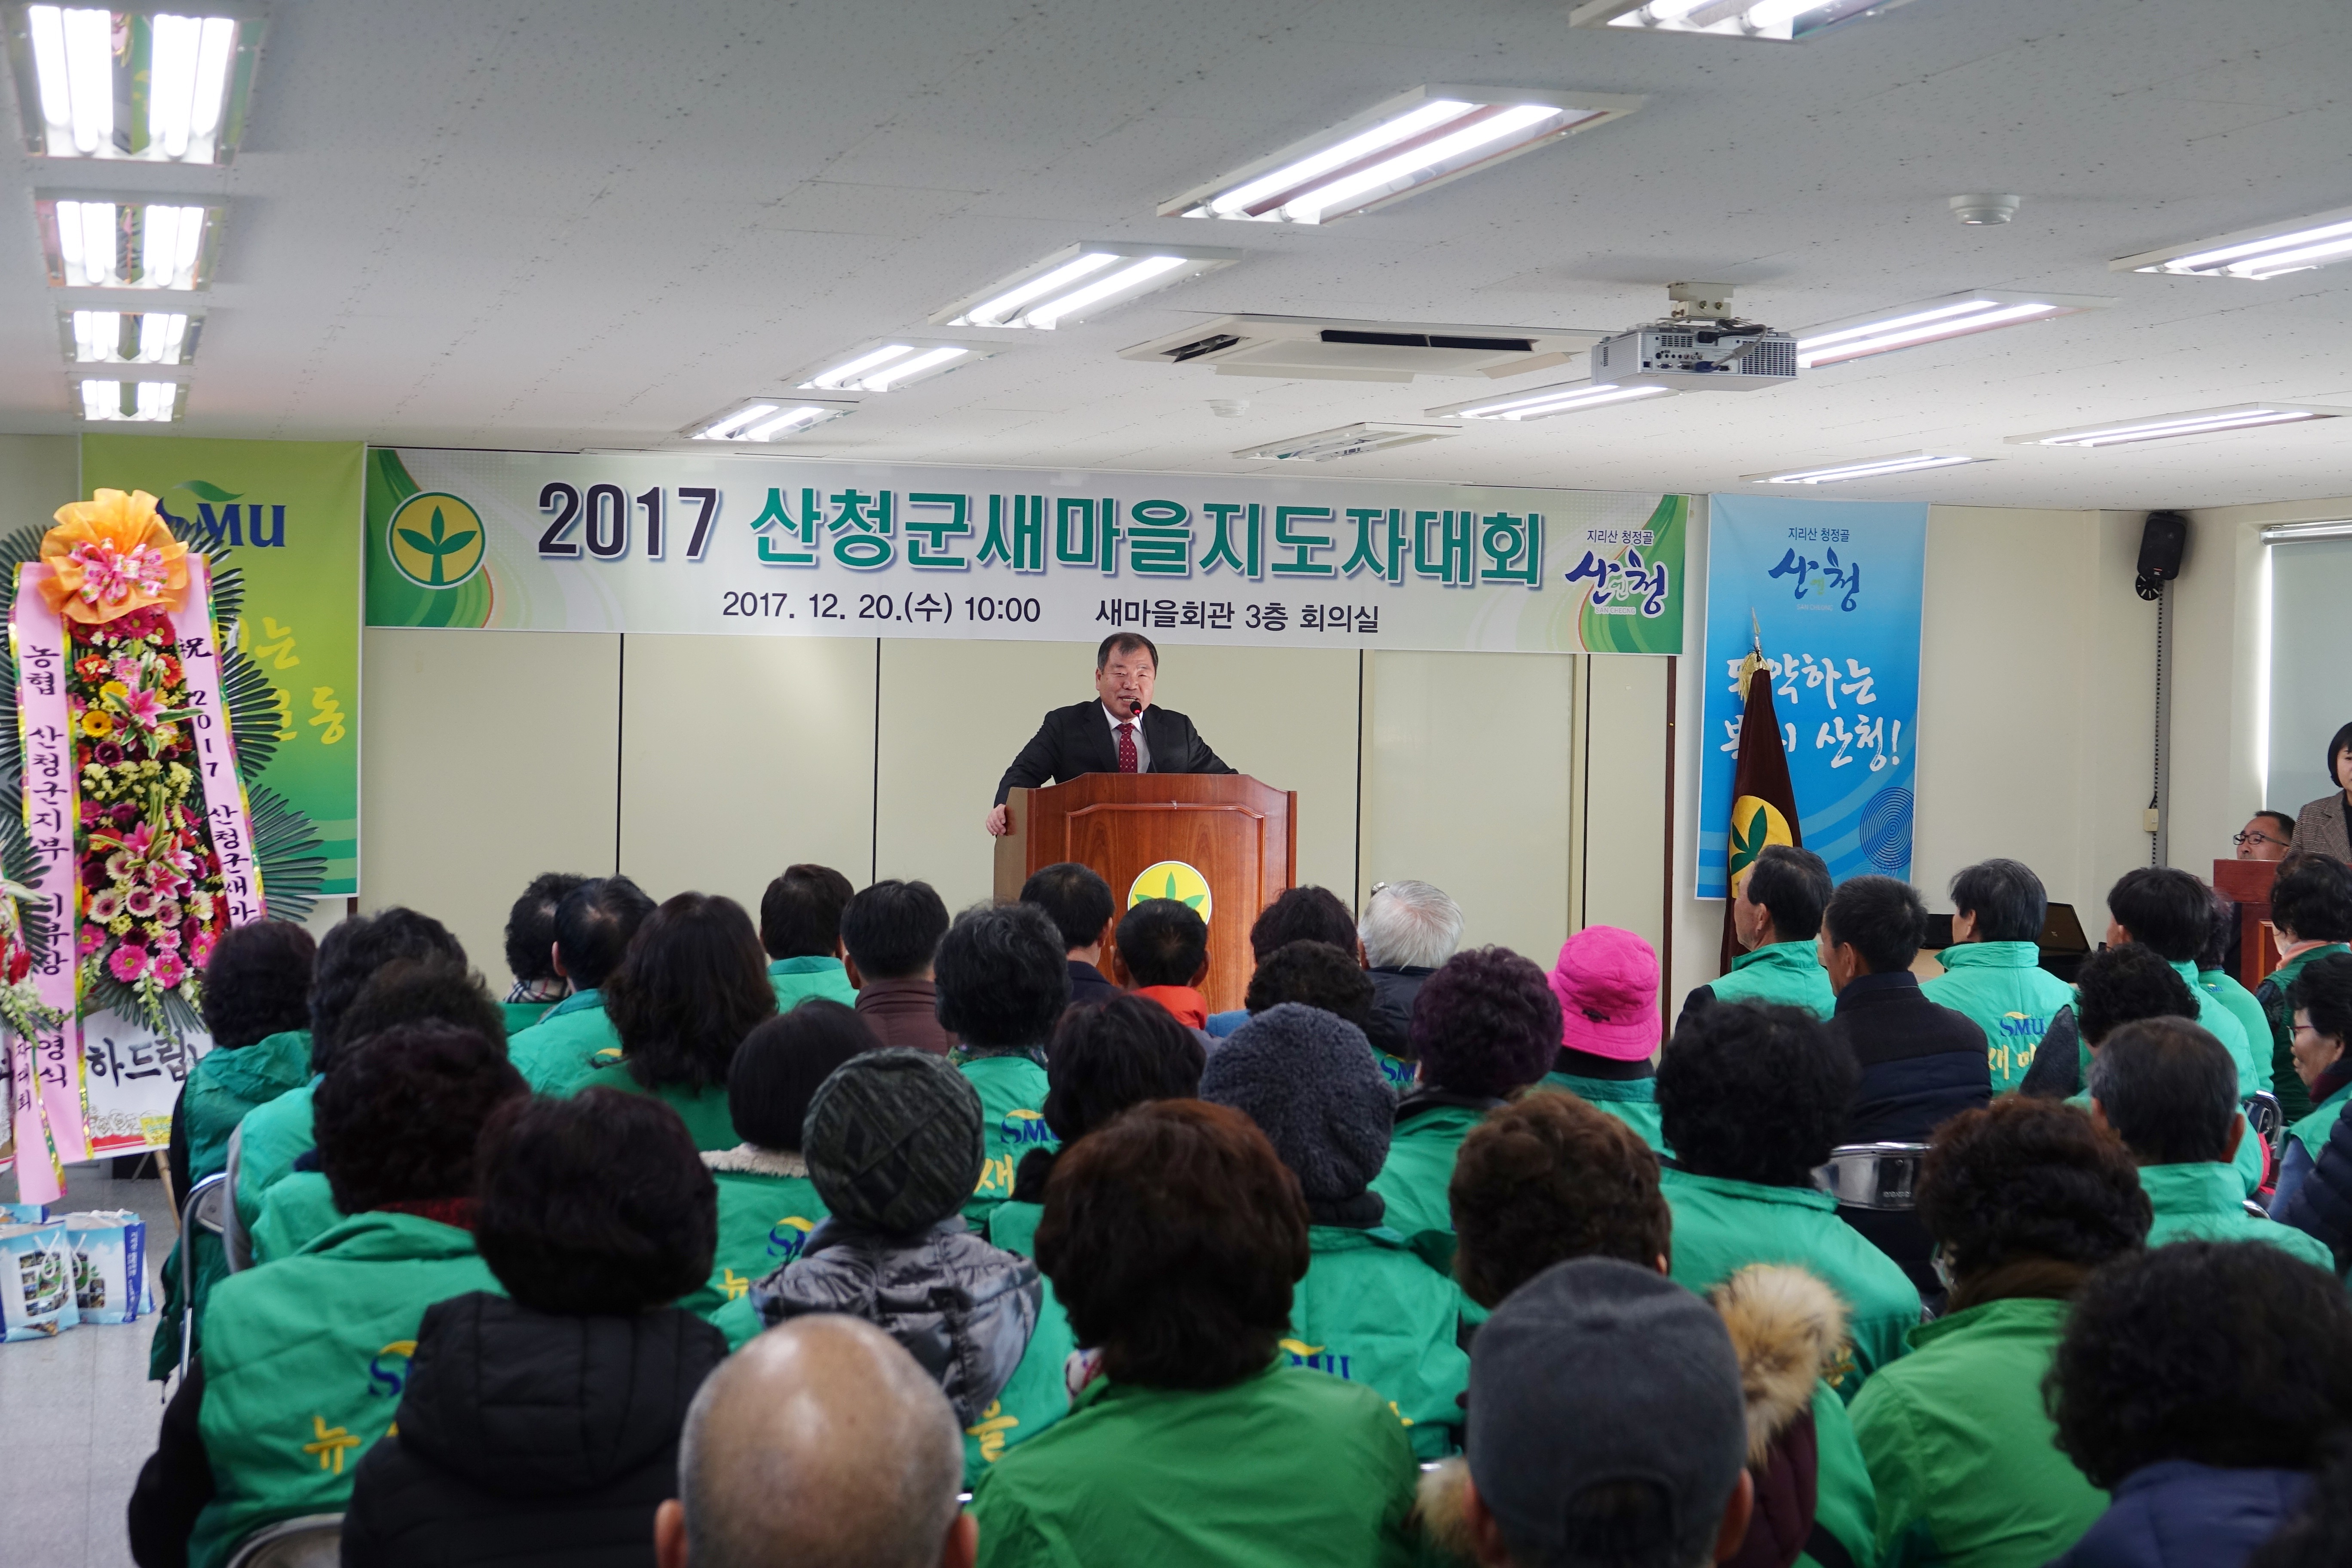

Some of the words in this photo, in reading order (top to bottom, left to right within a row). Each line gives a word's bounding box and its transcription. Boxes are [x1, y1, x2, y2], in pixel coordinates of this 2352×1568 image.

[538, 481, 717, 557] 2017
[750, 487, 1540, 585] 산청군새마을지도자대회
[1587, 530, 1618, 543] 지리산
[1621, 530, 1653, 545] 청정골
[1788, 527, 1817, 541] 지리산
[1821, 528, 1850, 542] 청정골
[723, 591, 795, 619] 2017.
[808, 593, 846, 620] 12.
[859, 591, 952, 623] 20.(수)
[965, 597, 1041, 622] 10:00
[1095, 598, 1235, 629] 새마을회관
[1245, 602, 1289, 631] 3층
[1300, 603, 1379, 634] 회의실
[178, 637, 214, 659] 祝
[23, 644, 61, 695] 농협
[1816, 714, 1901, 772] 산청!
[28, 725, 70, 861] 산청군지부
[208, 804, 262, 924] 산청군새마
[2000, 1018, 2046, 1037] SMU
[1001, 1119, 1060, 1144] SM
